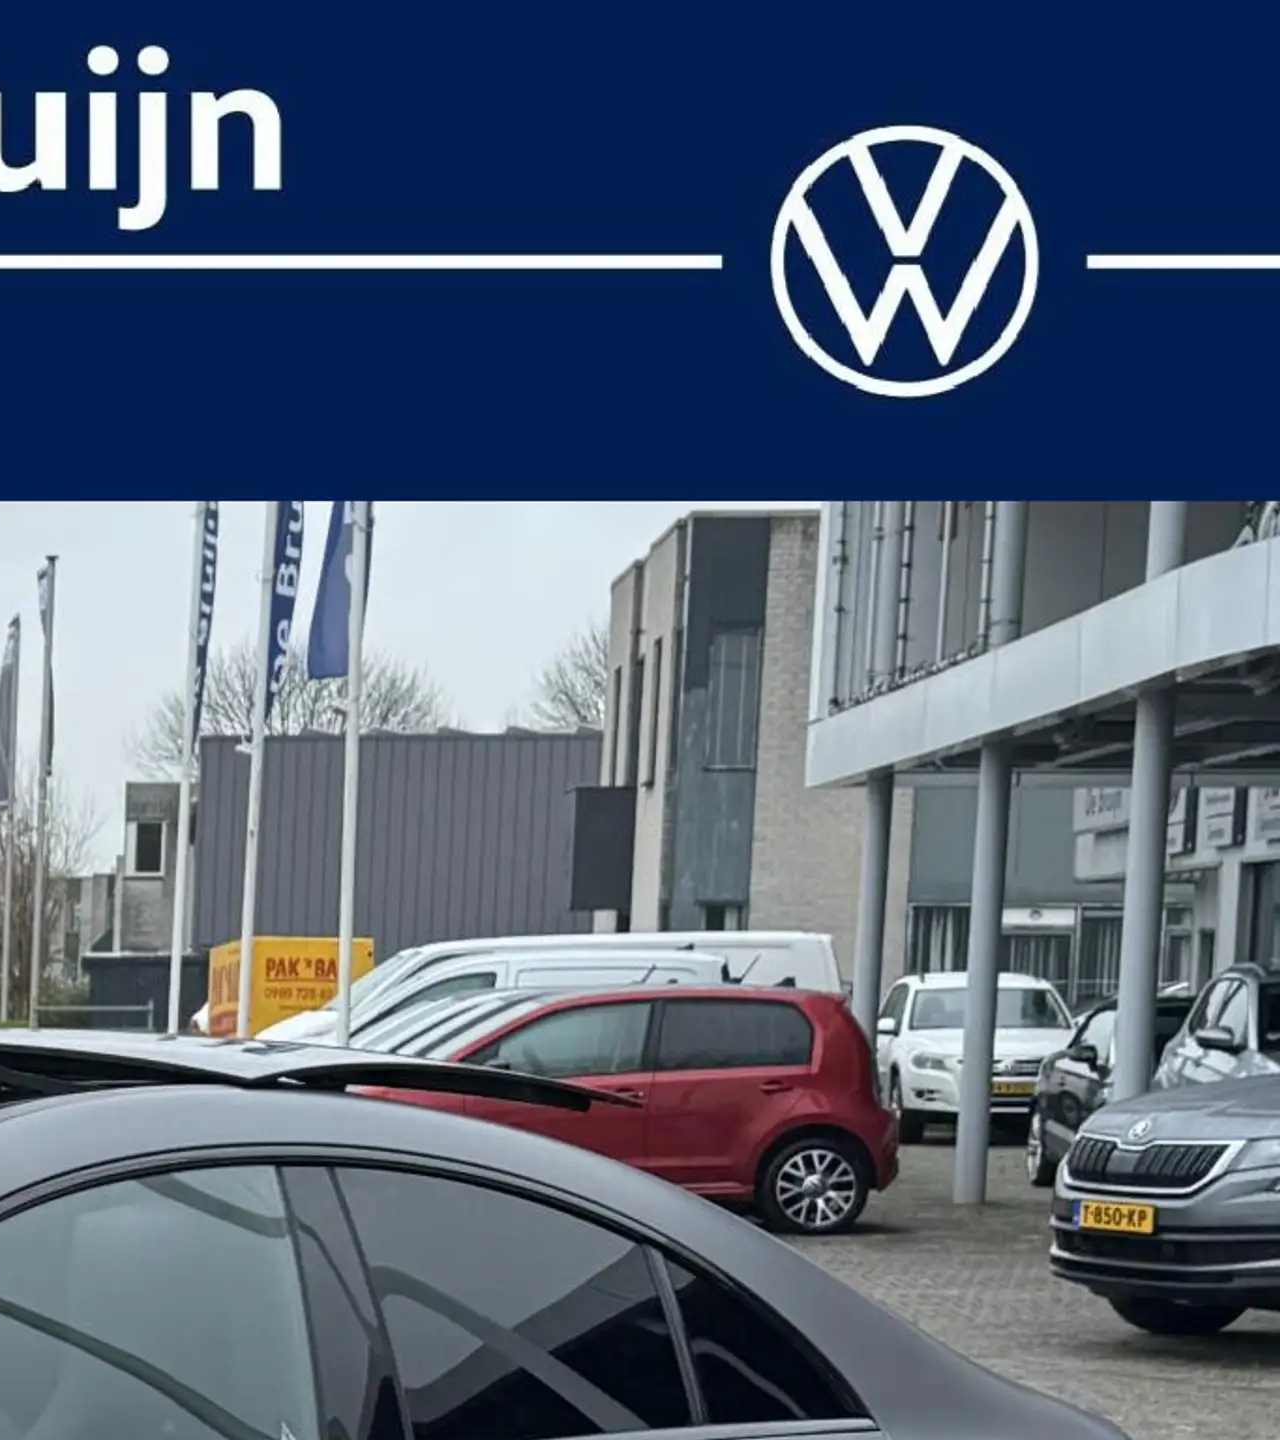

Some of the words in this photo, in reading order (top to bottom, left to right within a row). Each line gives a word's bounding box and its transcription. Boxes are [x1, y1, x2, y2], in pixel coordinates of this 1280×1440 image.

[266, 958, 300, 977] PAK
[315, 958, 338, 977] BA
[1084, 1205, 1148, 1228] T-850-KP
